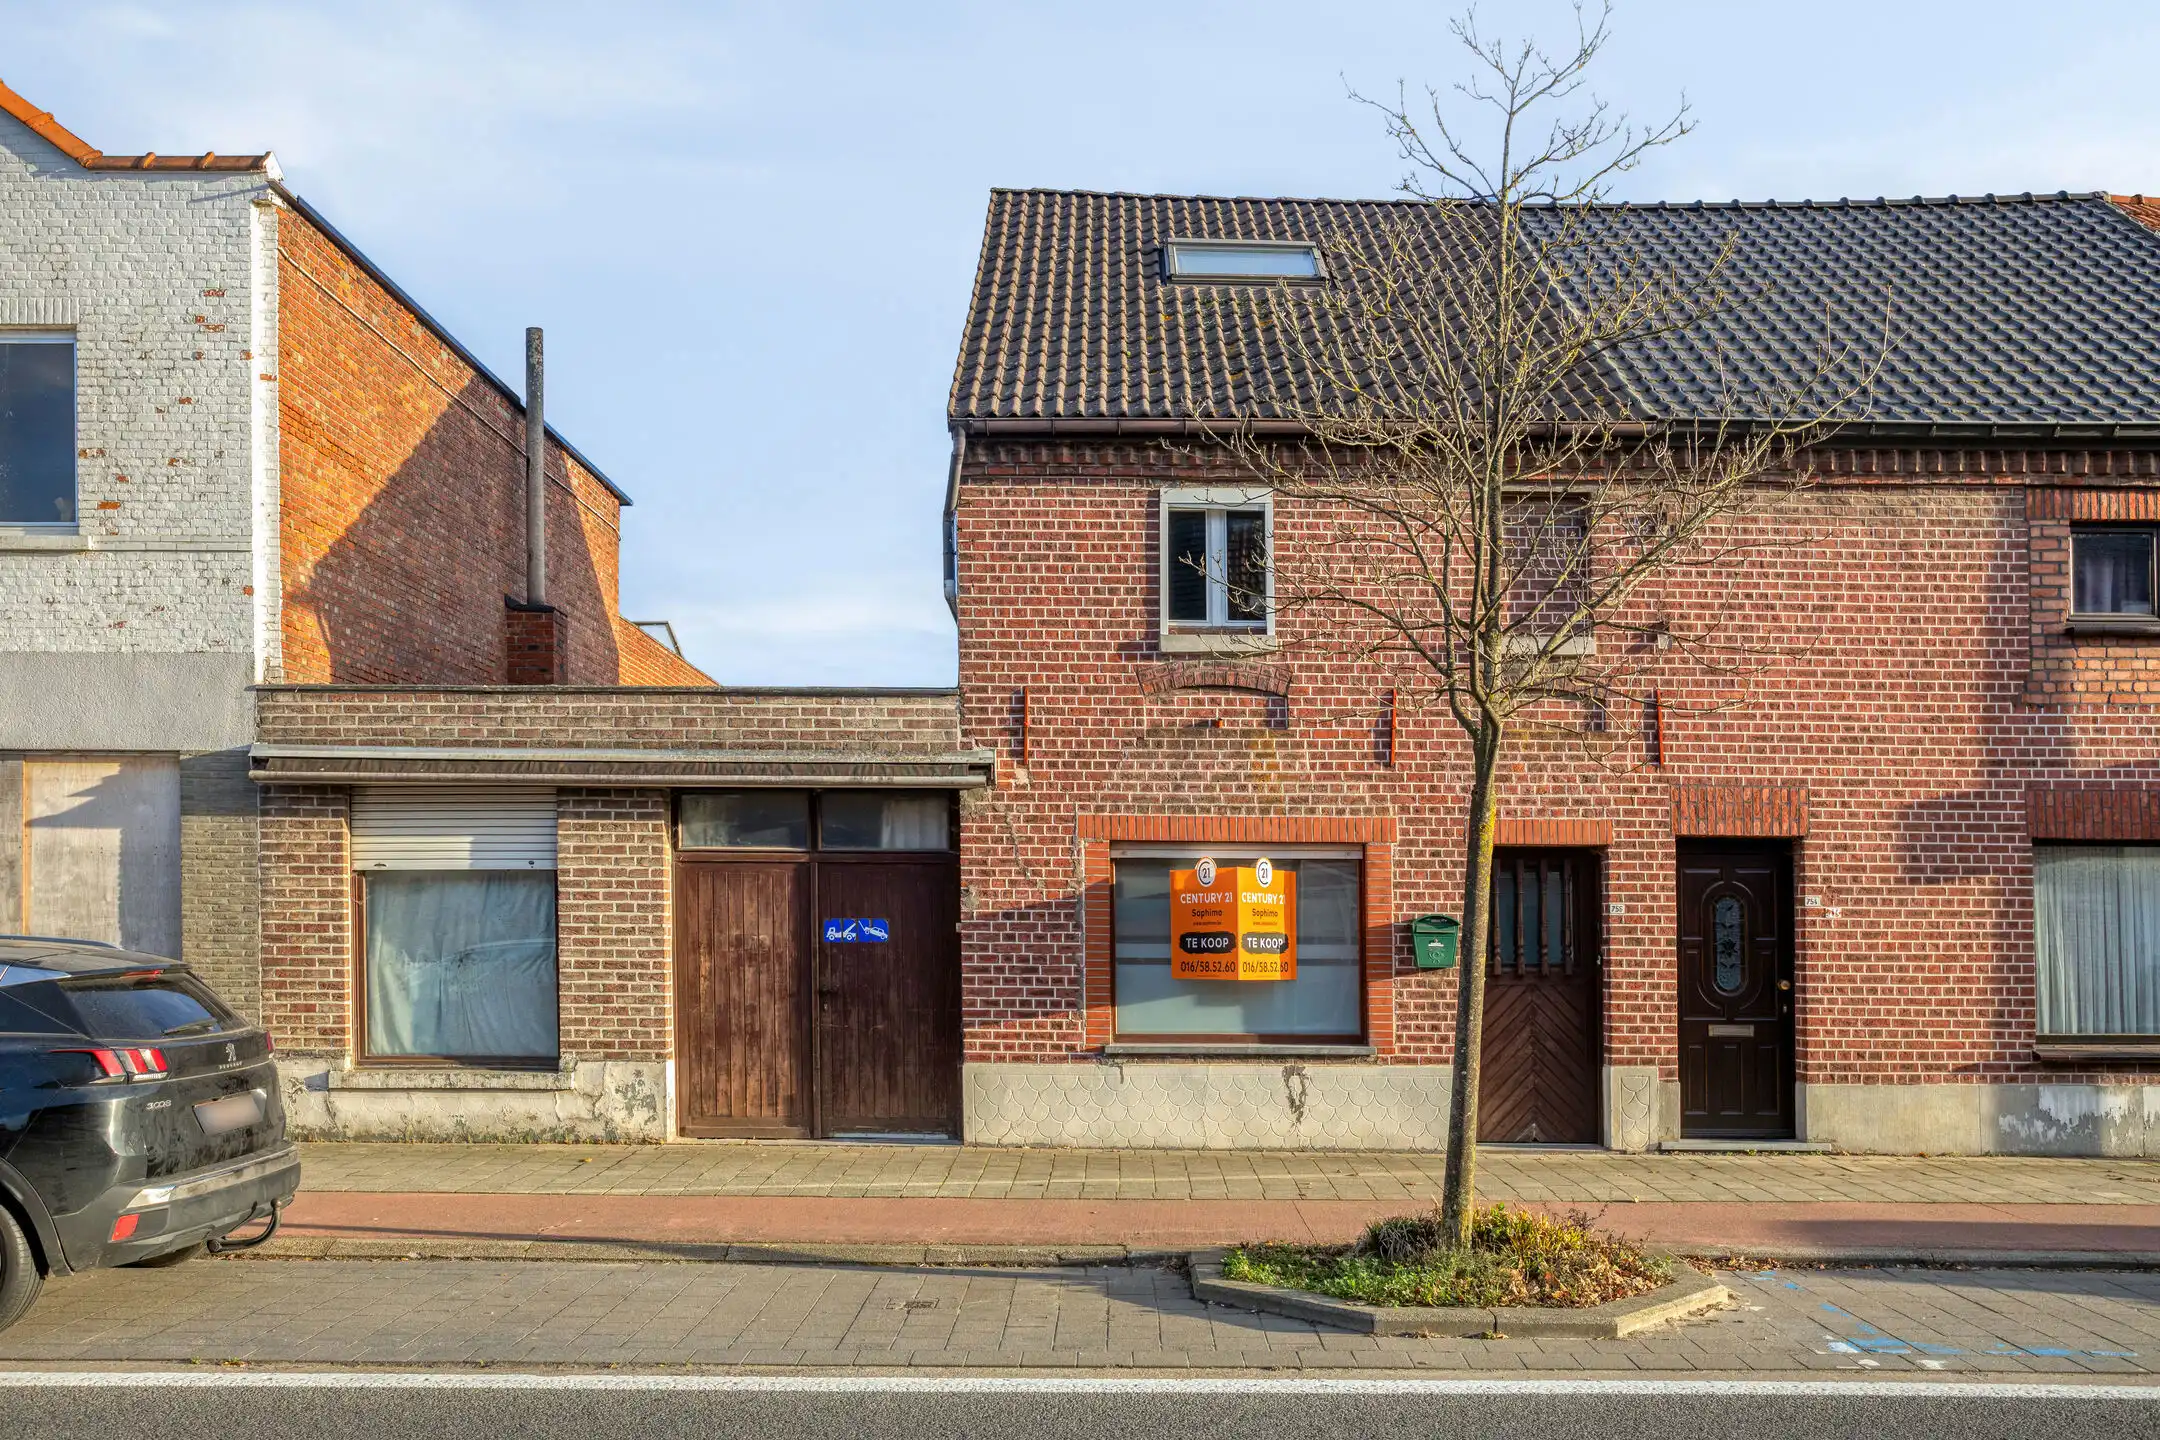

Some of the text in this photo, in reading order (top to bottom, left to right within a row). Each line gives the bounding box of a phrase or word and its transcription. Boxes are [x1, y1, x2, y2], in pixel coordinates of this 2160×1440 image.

[1180, 891, 1233, 904] CENTURY 21
[1241, 891, 1286, 905] CENTURY 21
[1191, 908, 1223, 919] Sophimo
[1251, 907, 1279, 919] Sophimo
[1185, 937, 1229, 948] TE KOOP
[1247, 937, 1284, 949] TE KOOP
[1180, 960, 1236, 973] 016/58.52.60
[1242, 961, 1289, 973] 016/58.52.60
[146, 1099, 172, 1110] 3008
